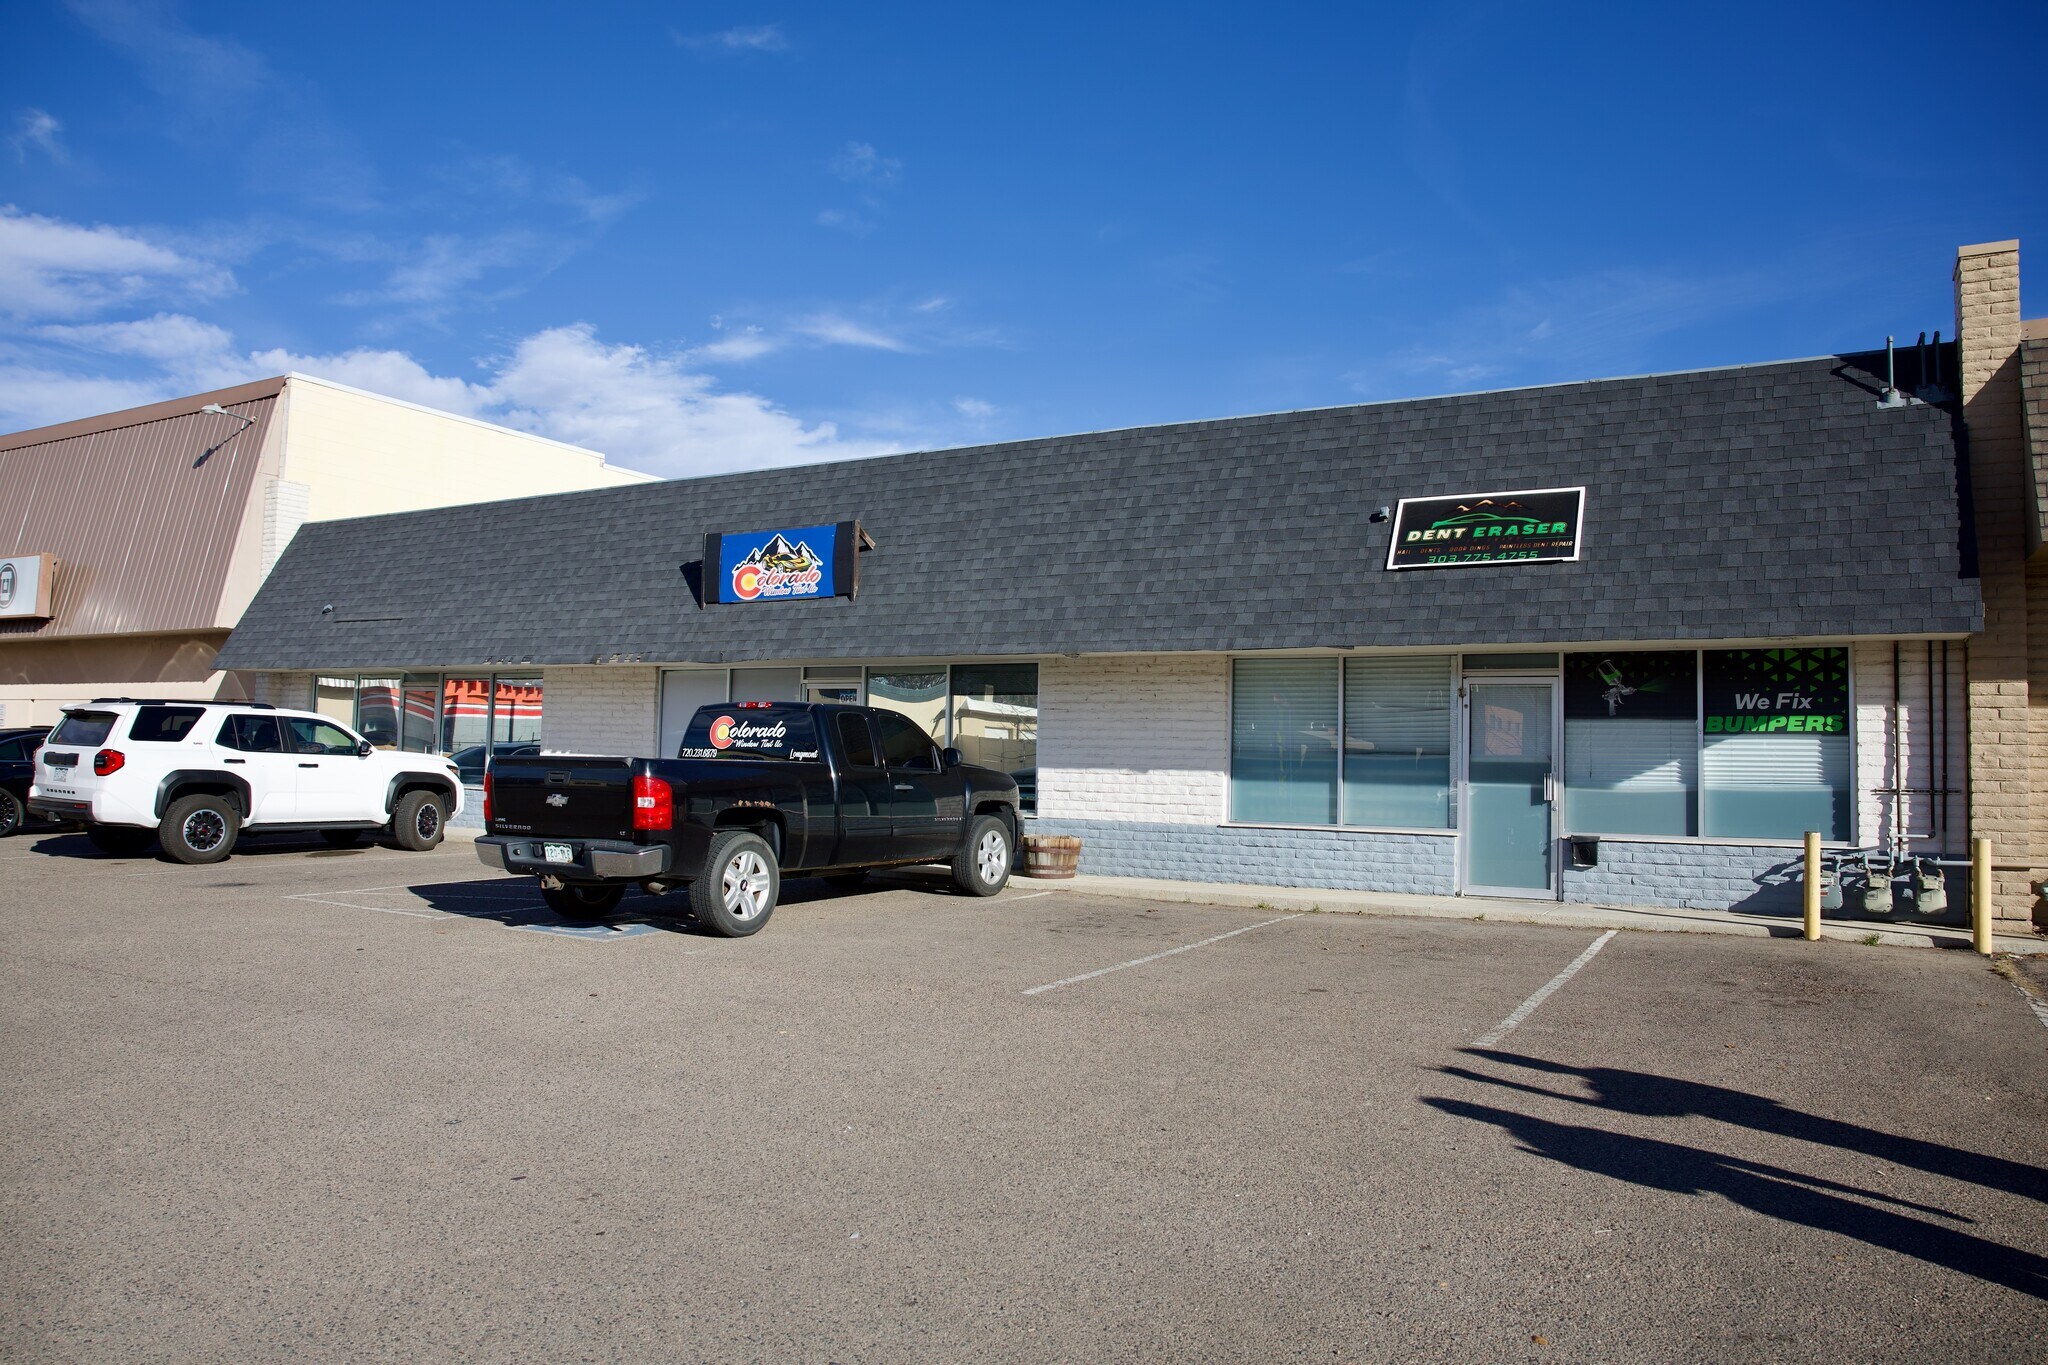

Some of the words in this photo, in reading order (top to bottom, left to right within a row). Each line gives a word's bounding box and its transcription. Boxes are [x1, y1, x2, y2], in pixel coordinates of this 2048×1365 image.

[1407, 527, 1468, 542] DENT
[1473, 522, 1567, 538] ERASER
[734, 564, 821, 598] Colorado
[840, 694, 857, 703] OPEN
[1735, 692, 1770, 710] We
[1775, 692, 1813, 710] Fix
[709, 715, 787, 750] Colorado
[1705, 714, 1844, 733] BUMPERS
[733, 739, 759, 748] Window
[760, 739, 773, 748] Tint
[789, 748, 819, 761] Longmont
